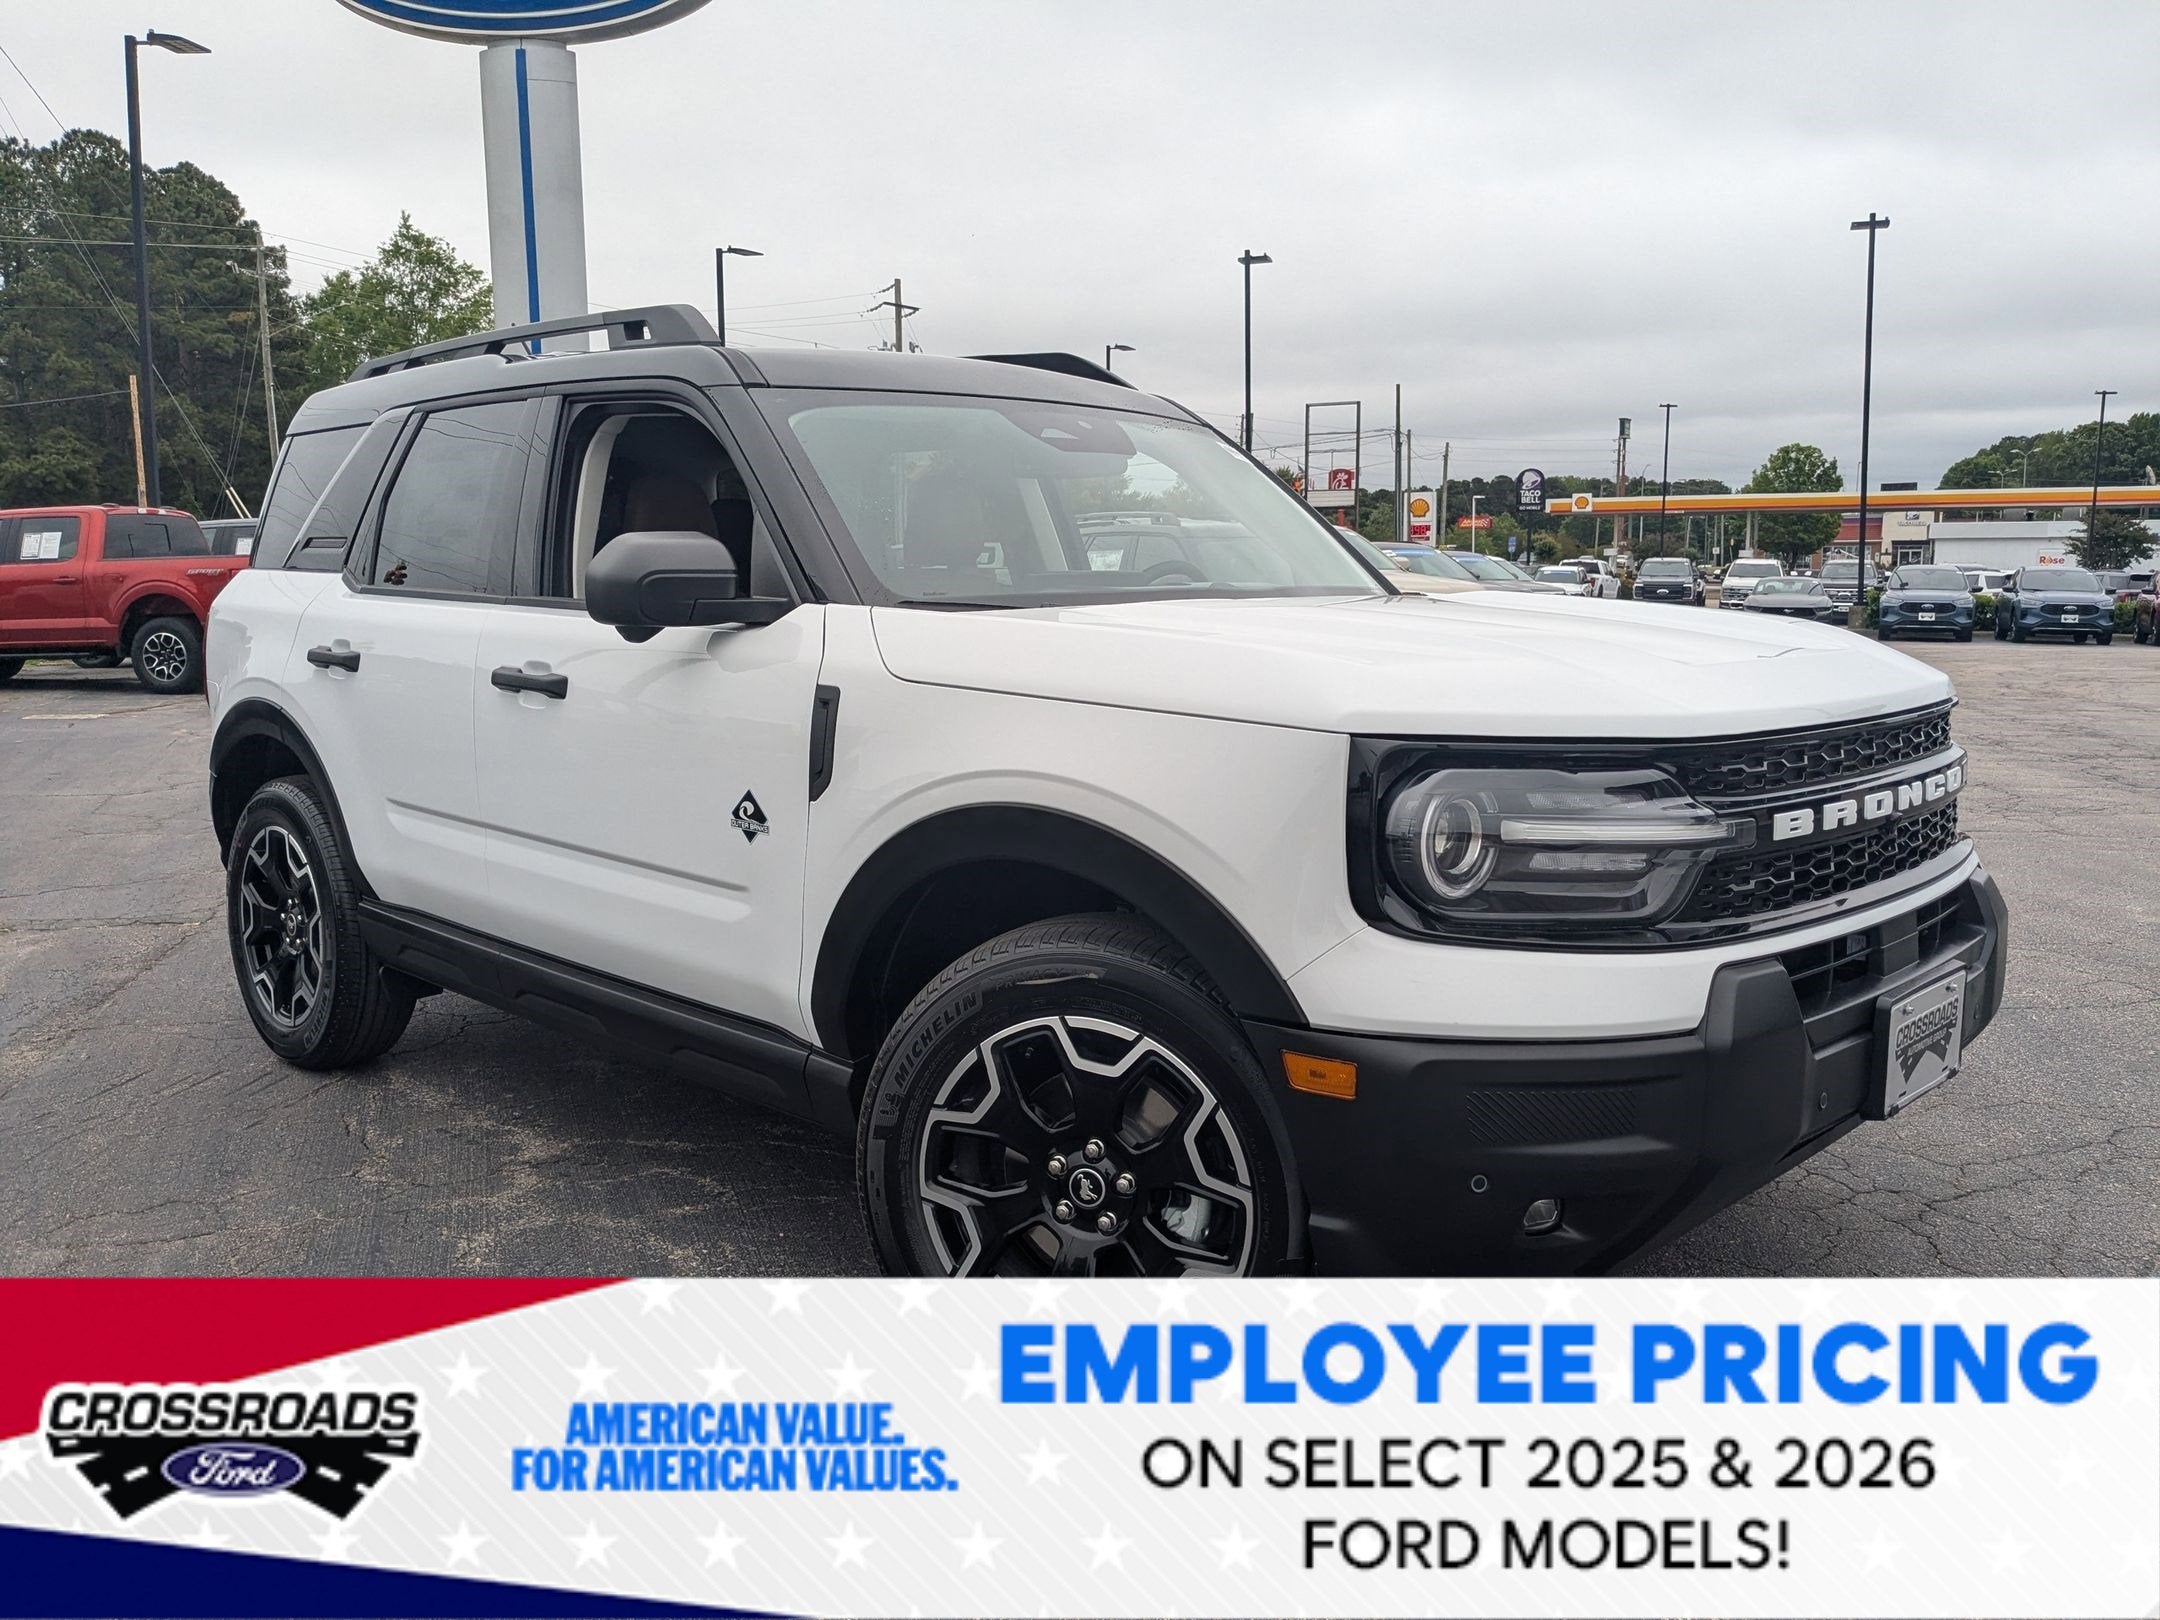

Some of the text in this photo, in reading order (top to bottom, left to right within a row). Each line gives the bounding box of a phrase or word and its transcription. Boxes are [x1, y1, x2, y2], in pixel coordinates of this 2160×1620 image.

[1520, 489, 1541, 497] TACO
[1773, 765, 1963, 841] BRONCO
[894, 991, 978, 1089] MICHELIN
[1896, 997, 1959, 1050] CROSSROADS
